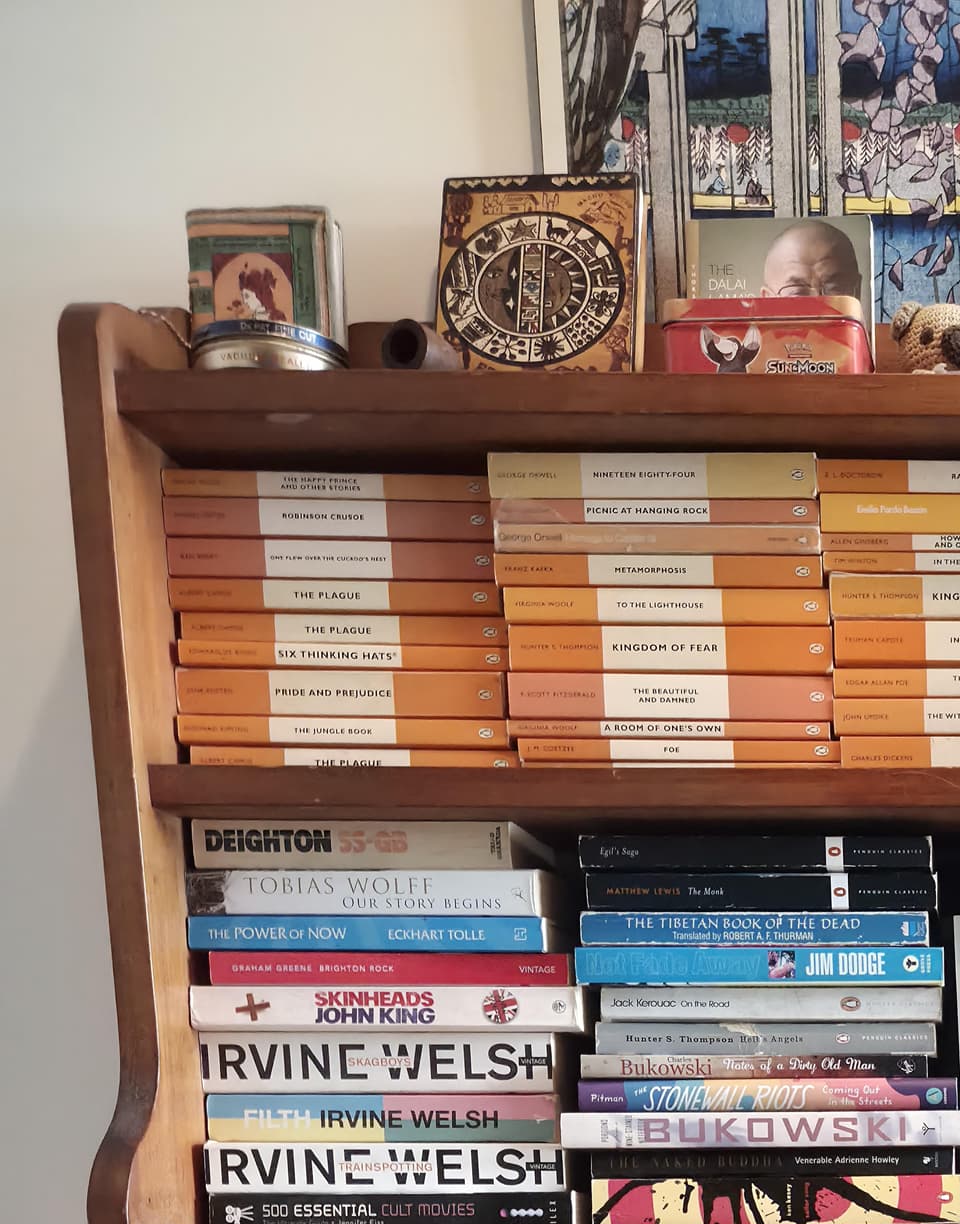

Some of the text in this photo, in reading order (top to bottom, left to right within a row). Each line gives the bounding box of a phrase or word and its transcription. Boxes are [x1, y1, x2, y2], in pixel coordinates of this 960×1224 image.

[708, 264, 734, 275] THE
[709, 279, 746, 290] DALAI
[282, 512, 365, 521] ROBINSON CRUSOE
[635, 507, 681, 515] HANGING
[684, 507, 708, 515] ROCK
[617, 601, 627, 609] TO
[630, 601, 647, 609] THE
[304, 626, 372, 635] THE PLAGUE
[612, 643, 718, 652] KINGDOM OF FEAR
[275, 688, 392, 698] PRIDE AND PREJUDICE
[204, 829, 408, 854] DEIGHTON SS-GB
[243, 876, 433, 895] TOBIAS WOLFF
[386, 898, 435, 909] STORY
[444, 898, 502, 910] BEGINS
[625, 917, 861, 930] THE TIBETAN BOOK OF THE DEAD
[208, 928, 230, 940] THE
[234, 927, 287, 940] POWER
[308, 927, 346, 940] NOW
[388, 929, 445, 941] ECKHART
[448, 930, 485, 941] TOLLE
[806, 952, 885, 976] JIM DODGE
[315, 991, 434, 1007] SKINHEADS
[315, 1008, 435, 1024] JOHN KING
[620, 1059, 713, 1077] Bukowski
[590, 1094, 624, 1103] Pitman
[643, 1085, 815, 1112] STONEWALL RIOTS
[243, 1109, 499, 1128] FILTH IRVINE WELSH
[643, 1117, 906, 1143] BUKOWSKI
[795, 1156, 899, 1166] Venerable Adrienne Howley
[262, 1203, 475, 1217] 500 ESSENTIAL CULT MOVIES
